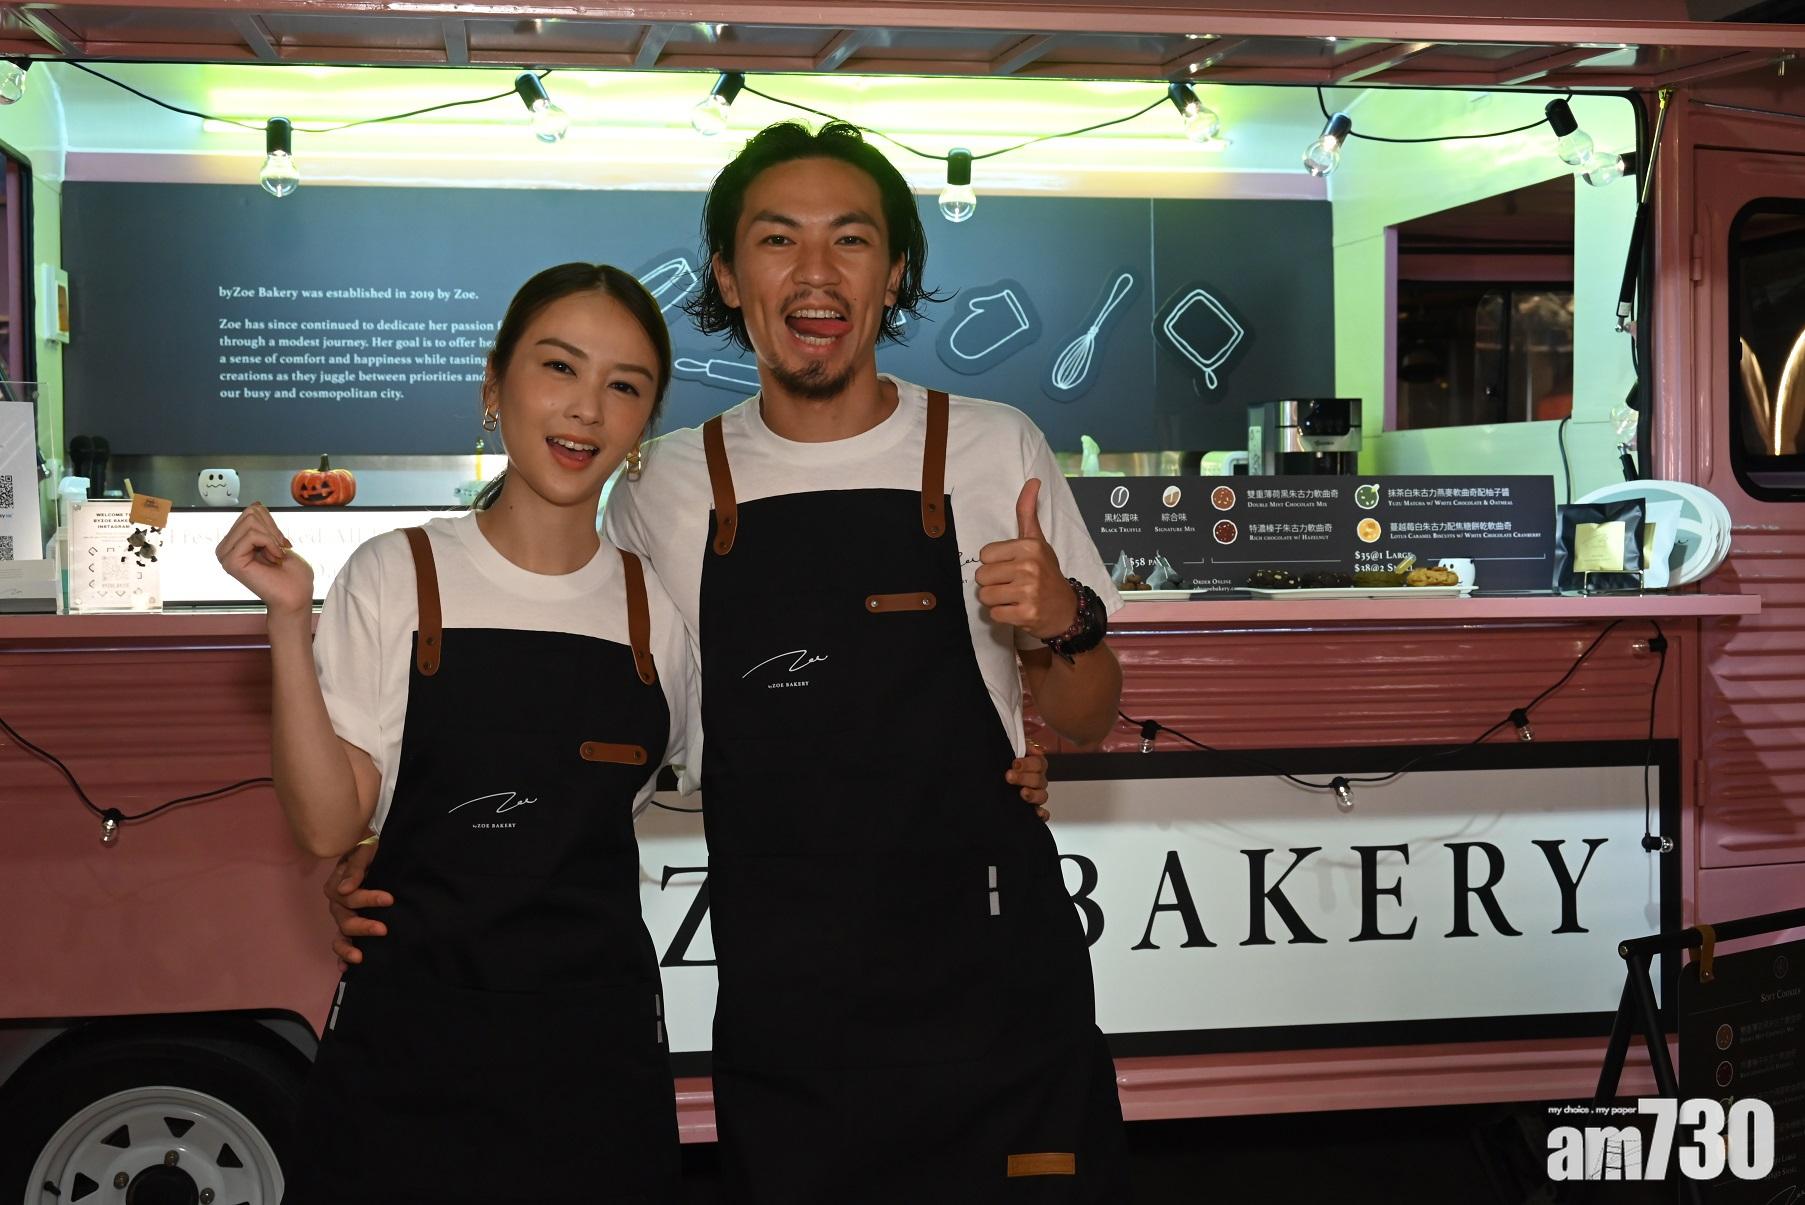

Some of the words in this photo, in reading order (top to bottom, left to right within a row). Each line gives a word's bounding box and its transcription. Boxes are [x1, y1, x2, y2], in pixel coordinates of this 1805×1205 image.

[219, 286, 254, 300] byZoe
[258, 287, 298, 300] Bakery
[302, 290, 323, 298] was
[326, 288, 392, 299] established
[395, 288, 406, 298] in
[410, 290, 434, 301] 2019
[438, 288, 450, 302] by
[454, 288, 478, 300] Zoe.
[219, 319, 241, 330] Zoe
[244, 318, 264, 330] has
[268, 320, 297, 330] since
[300, 319, 359, 330] continued
[362, 321, 374, 330] to
[377, 320, 425, 331] dedicate
[428, 320, 448, 331] her
[451, 321, 494, 334] passion
[219, 336, 265, 348] through
[278, 336, 319, 347] modest
[322, 338, 368, 350] journey.
[372, 337, 392, 348] Her
[396, 337, 419, 350] goal
[422, 338, 432, 348] is
[435, 339, 446, 348] to
[449, 337, 476, 348] offer
[264, 353, 277, 364] of
[280, 353, 325, 364] comfort
[328, 354, 350, 364] and
[354, 354, 412, 366] happiness
[415, 355, 446, 365] while
[450, 356, 487, 368] tasting
[220, 372, 273, 381] creations
[292, 371, 317, 383] they
[320, 371, 355, 384] juggle
[359, 371, 406, 382] between
[409, 372, 462, 384] priorities
[220, 390, 240, 398] our
[244, 388, 270, 400] busy
[274, 388, 296, 398] and
[300, 388, 377, 401] cosmopolitan
[380, 388, 404, 400] city.
[1104, 513, 1139, 522] 黑松露味
[1161, 513, 1187, 522] 綜合味
[1129, 557, 1145, 567] $58
